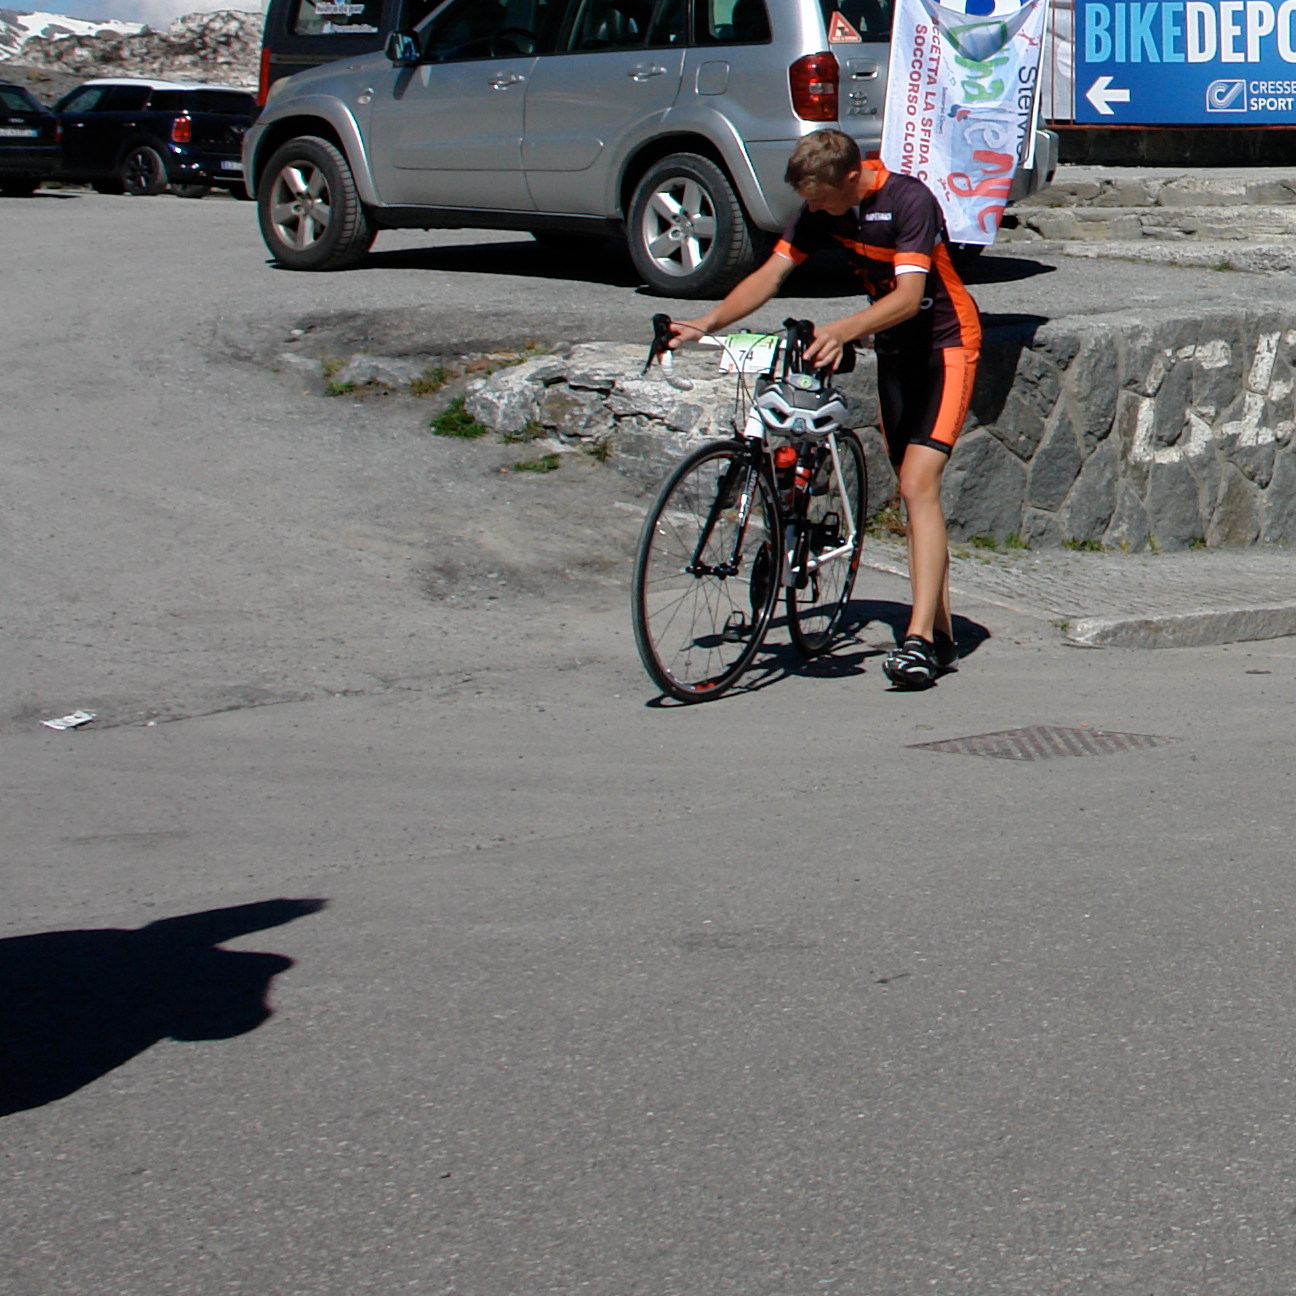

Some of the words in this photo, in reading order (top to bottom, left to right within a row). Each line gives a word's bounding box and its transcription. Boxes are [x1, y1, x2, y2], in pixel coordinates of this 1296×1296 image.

[907, 24, 927, 116] SOCCORSO
[923, 91, 936, 111] LA
[1250, 98, 1294, 111] SPORT
[919, 117, 933, 164] SFIDA
[739, 349, 754, 361] 74
